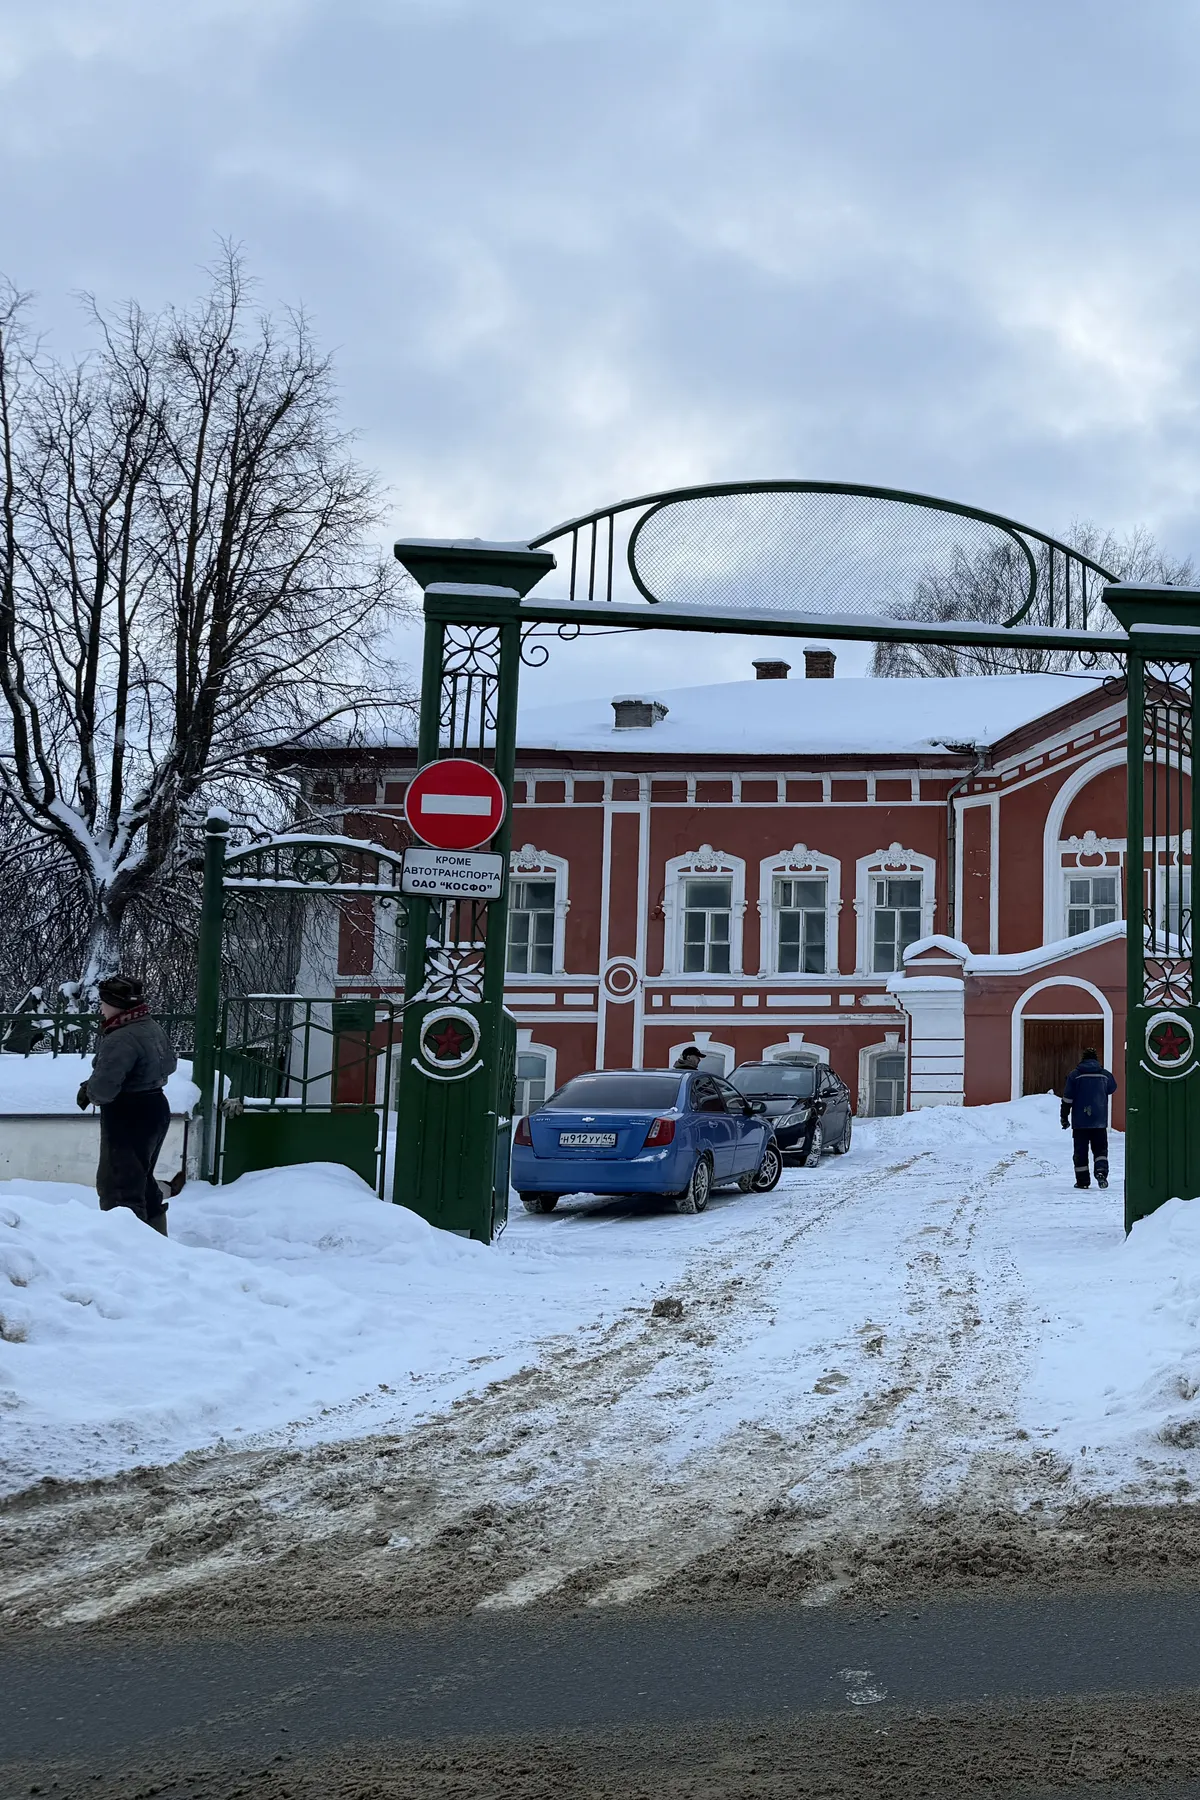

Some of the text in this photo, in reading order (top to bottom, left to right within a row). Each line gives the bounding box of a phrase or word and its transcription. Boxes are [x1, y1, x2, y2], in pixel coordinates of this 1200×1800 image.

[435, 856, 472, 866] КРОМЕ
[403, 866, 501, 881] АВТОТРАНСПОРТА
[411, 879, 437, 889] ОАО
[563, 1134, 613, 1144] Н912УУ 44
